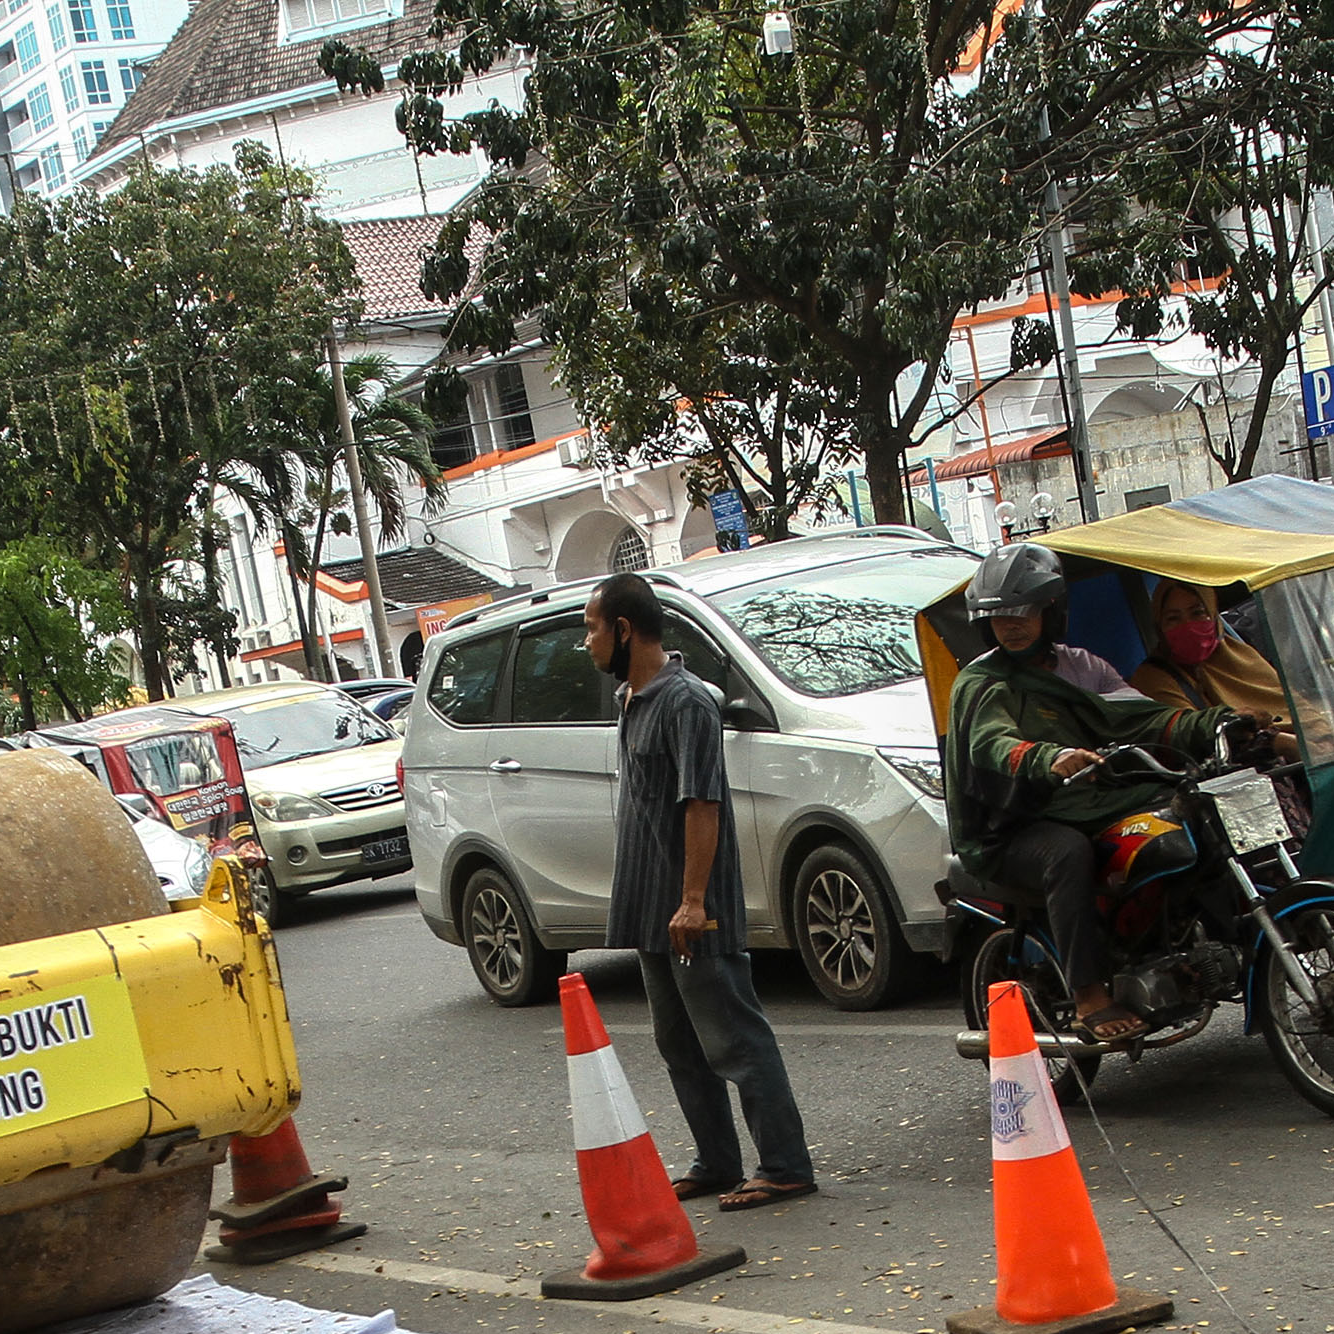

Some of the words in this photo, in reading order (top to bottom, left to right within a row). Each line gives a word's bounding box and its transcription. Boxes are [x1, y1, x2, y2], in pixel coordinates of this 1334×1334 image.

[1312, 370, 1331, 423] P
[198, 781, 228, 795] Korean
[201, 793, 225, 805] Spicy
[224, 785, 244, 797] Soup
